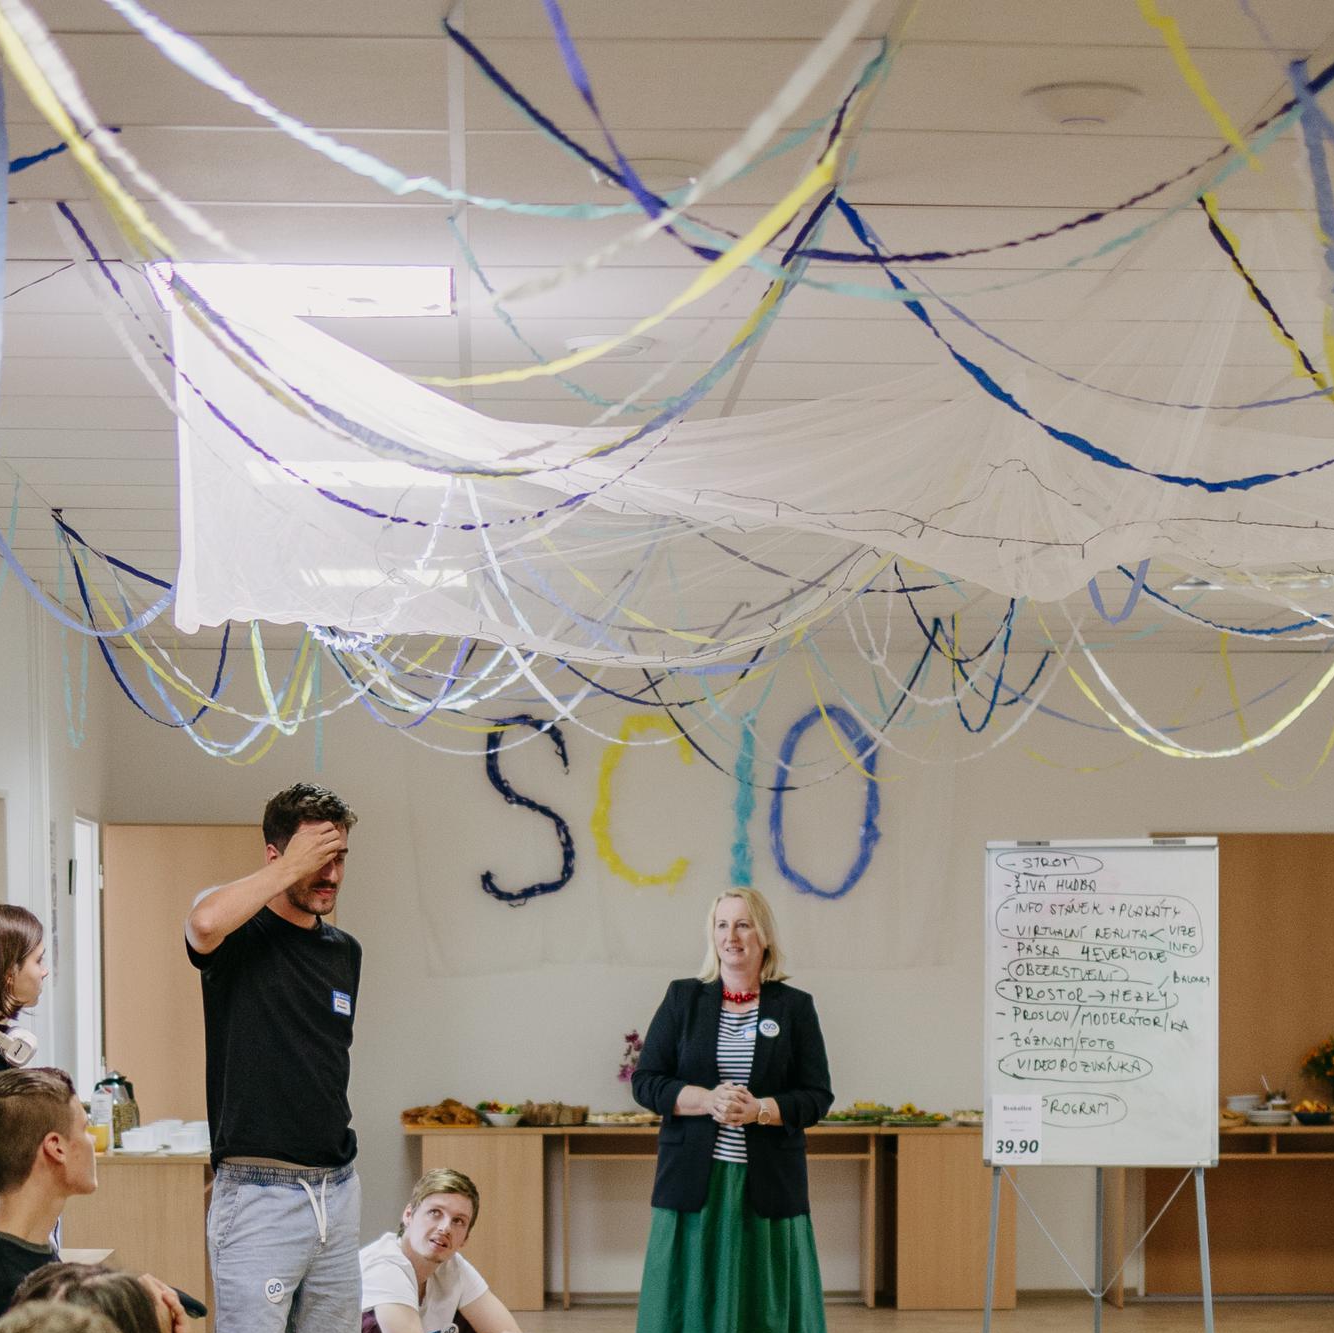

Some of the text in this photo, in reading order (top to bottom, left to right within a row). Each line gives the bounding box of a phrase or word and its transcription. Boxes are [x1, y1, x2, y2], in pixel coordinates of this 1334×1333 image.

[481, 704, 880, 907] SCIO
[1022, 856, 1080, 871] STROM
[1056, 878, 1097, 893] HUDBA
[1015, 901, 1043, 914] INFO
[1050, 898, 1104, 916] STÁNEK
[1095, 927, 1147, 940] REALITA
[1169, 925, 1196, 938] VIZE
[1017, 940, 1167, 963] PÁSKA 4EVERYONE
[1169, 941, 1197, 954] INFO
[1015, 985, 1087, 1003] PROSTOR
[995, 1139, 1039, 1154] 39.90
